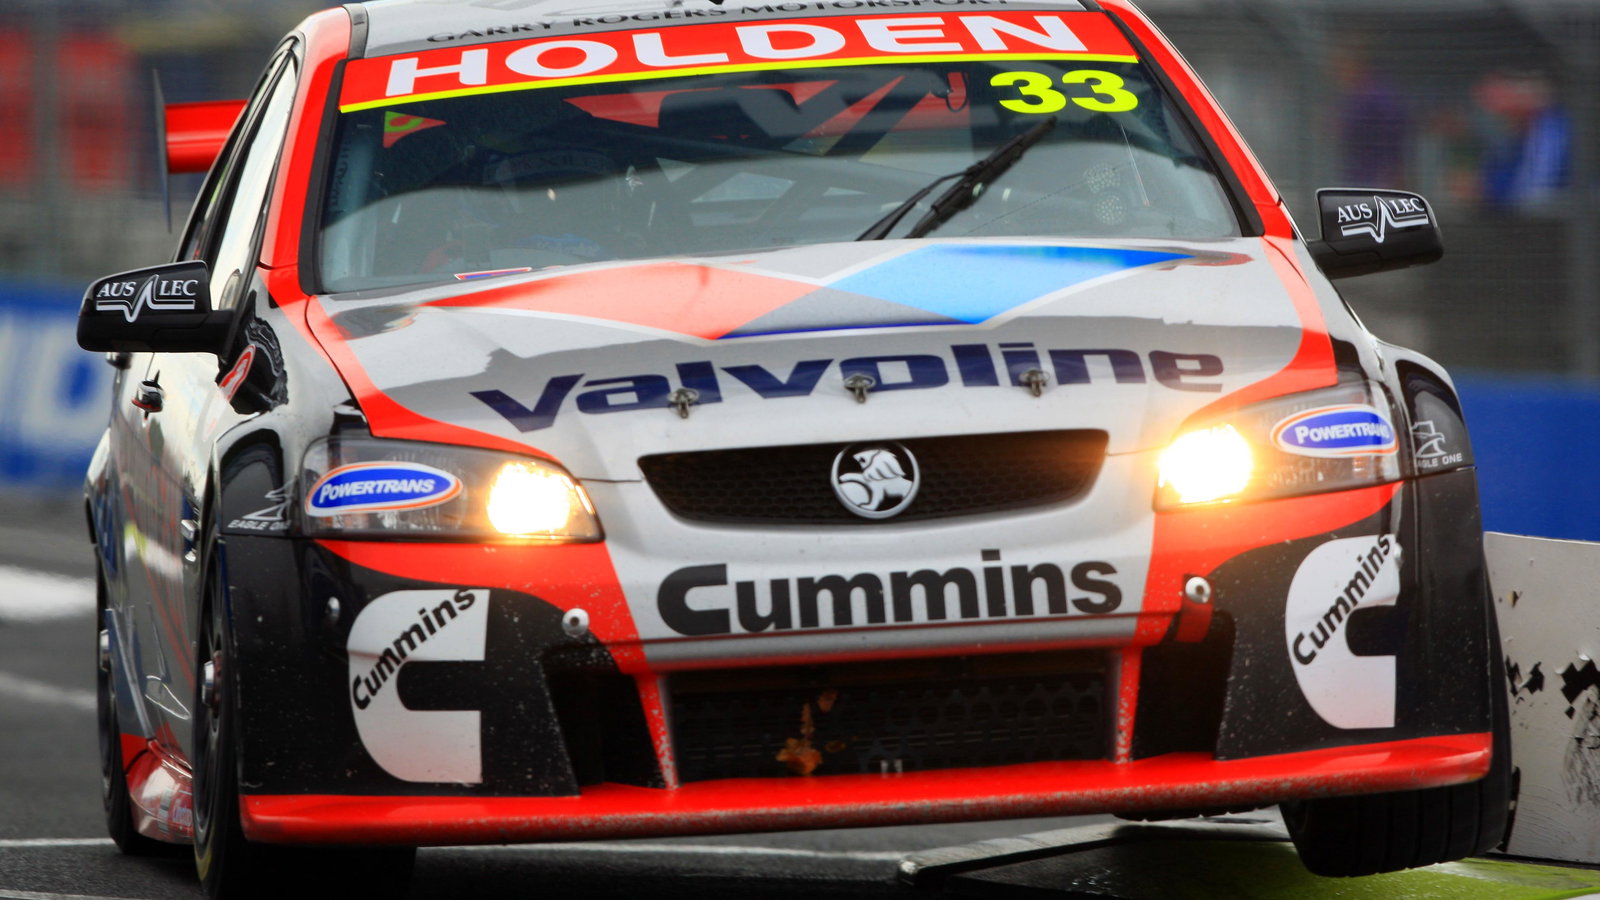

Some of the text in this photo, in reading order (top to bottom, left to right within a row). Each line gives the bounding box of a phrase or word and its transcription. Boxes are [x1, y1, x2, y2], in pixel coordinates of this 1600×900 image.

[385, 15, 1088, 97] HOLDEN
[426, 20, 554, 42] GARRY
[573, 9, 727, 27] ROGERS
[990, 69, 1138, 114] 33
[1442, 453, 1463, 465] ONE
[227, 519, 270, 530] EAGLE
[656, 548, 1124, 637] Cummins
[1292, 534, 1391, 665] Cummins
[352, 588, 476, 710] Cummins
